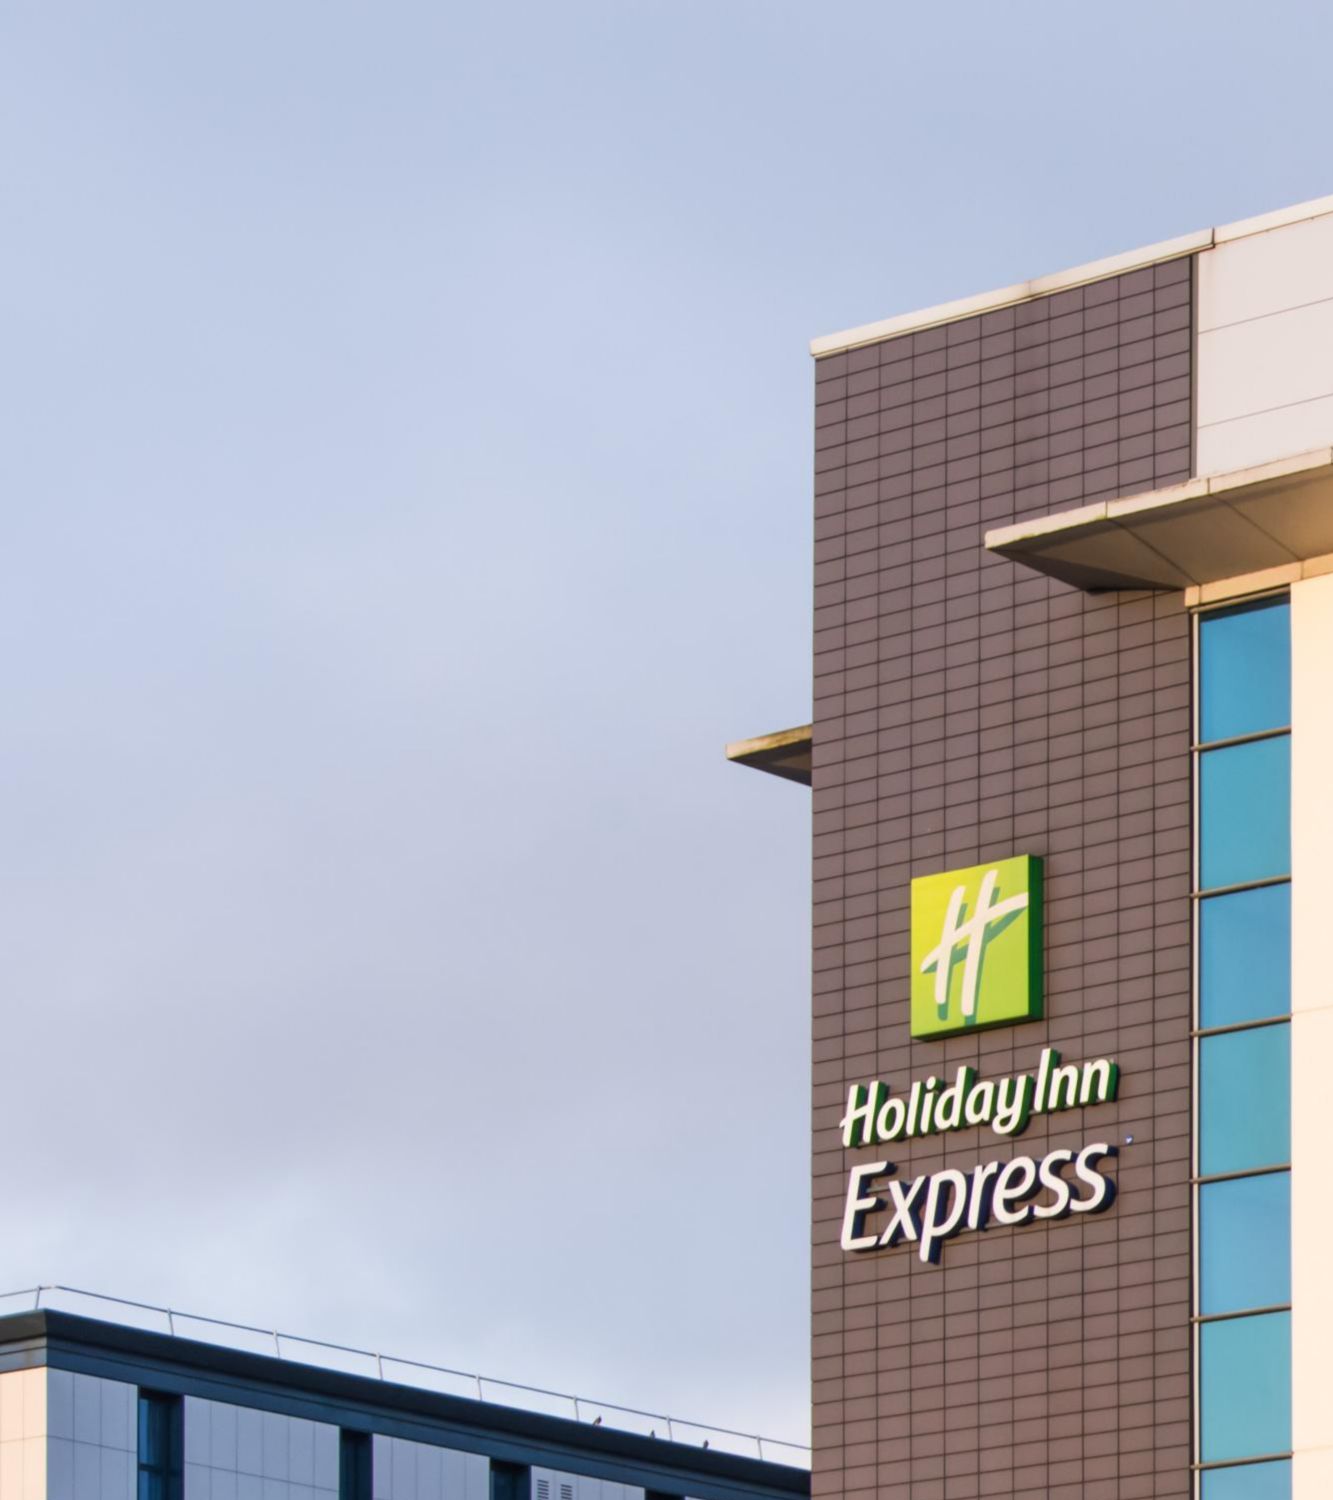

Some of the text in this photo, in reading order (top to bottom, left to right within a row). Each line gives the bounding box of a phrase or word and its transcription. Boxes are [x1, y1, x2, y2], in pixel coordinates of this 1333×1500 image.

[839, 1048, 1117, 1148] Holiday Inn
[840, 1142, 1116, 1264] Express
